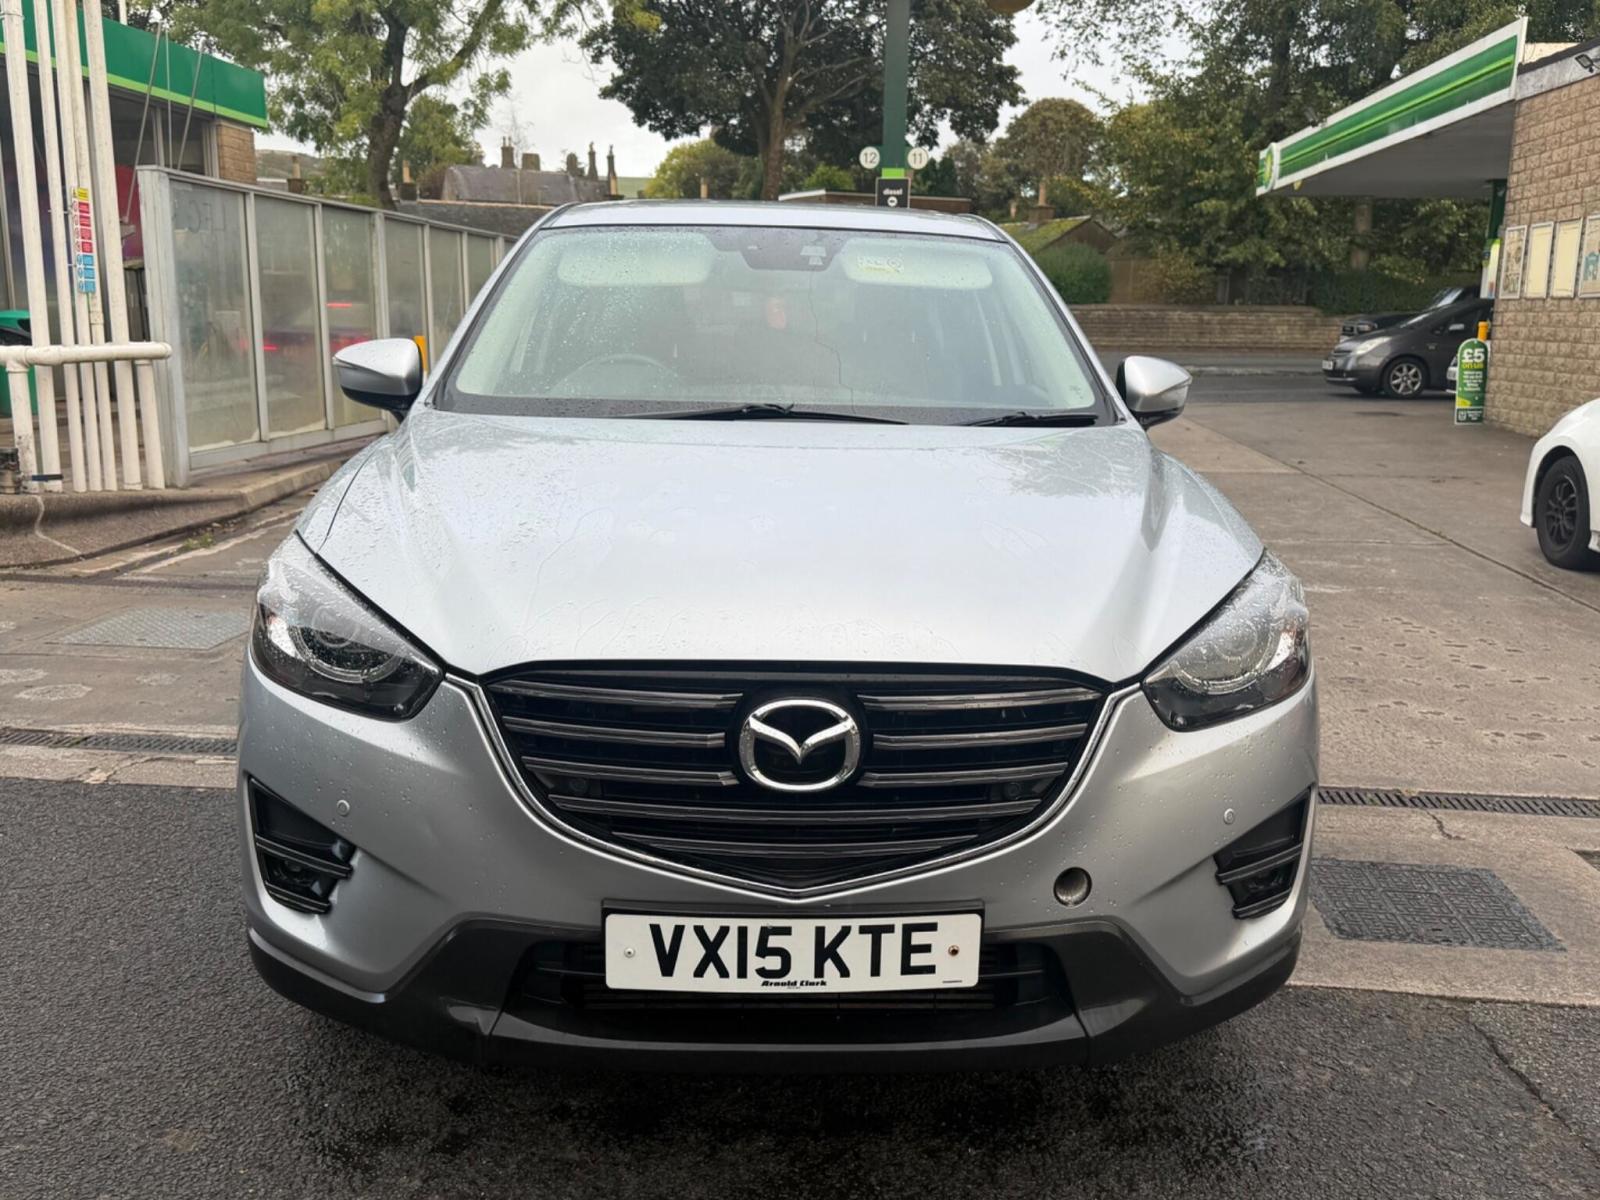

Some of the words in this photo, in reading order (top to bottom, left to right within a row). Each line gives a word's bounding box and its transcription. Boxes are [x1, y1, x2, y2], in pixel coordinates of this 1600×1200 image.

[863, 151, 877, 164] 12
[912, 152, 923, 164] 11
[1461, 348, 1485, 362] £5
[649, 923, 793, 979] VX15
[813, 922, 938, 979] KTE
